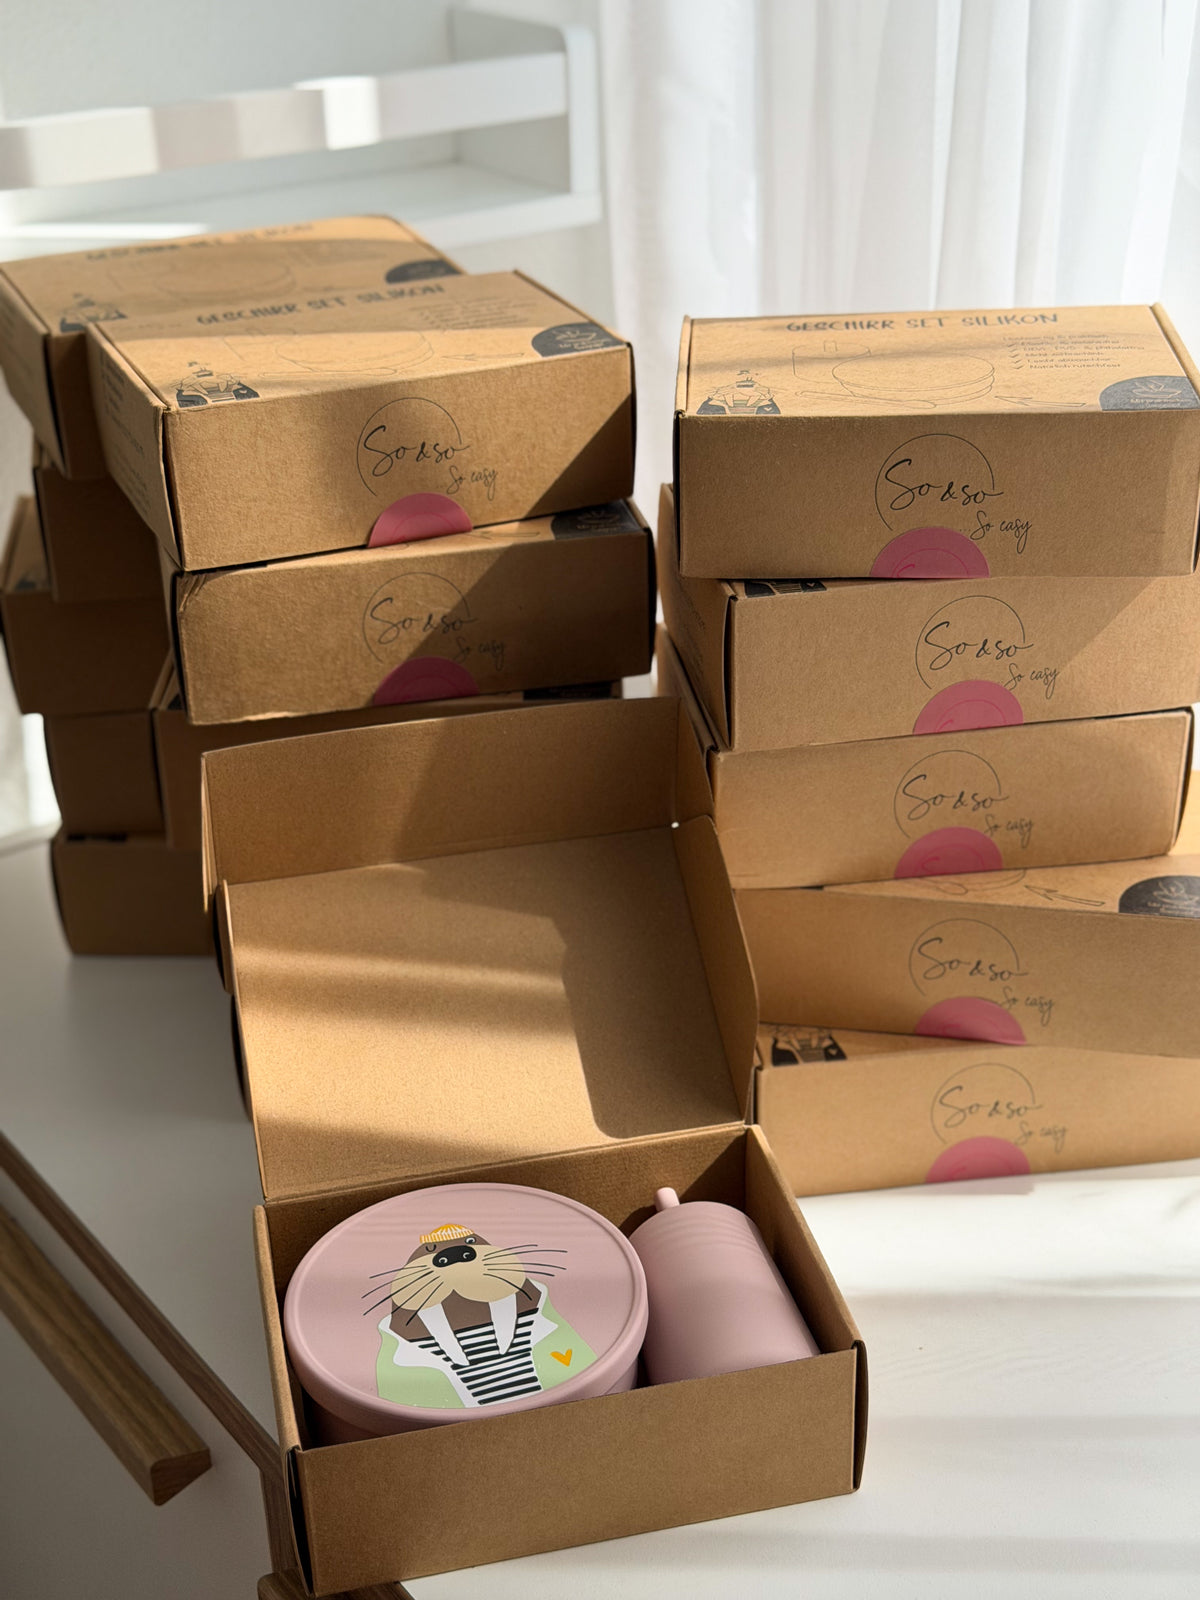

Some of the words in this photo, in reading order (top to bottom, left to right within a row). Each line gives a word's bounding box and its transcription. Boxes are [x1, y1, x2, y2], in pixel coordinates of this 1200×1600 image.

[786, 319, 895, 333] GESCHIRR
[906, 316, 949, 329] SET
[961, 313, 1059, 328] SILIKON
[363, 424, 417, 478] So
[470, 467, 499, 501] easy
[885, 458, 943, 511] So
[999, 518, 1033, 555] easy
[370, 597, 424, 645] So
[924, 621, 978, 671] So
[1029, 667, 1060, 700] easy
[902, 774, 955, 821] So
[918, 936, 971, 980] So
[938, 1085, 990, 1129] So
